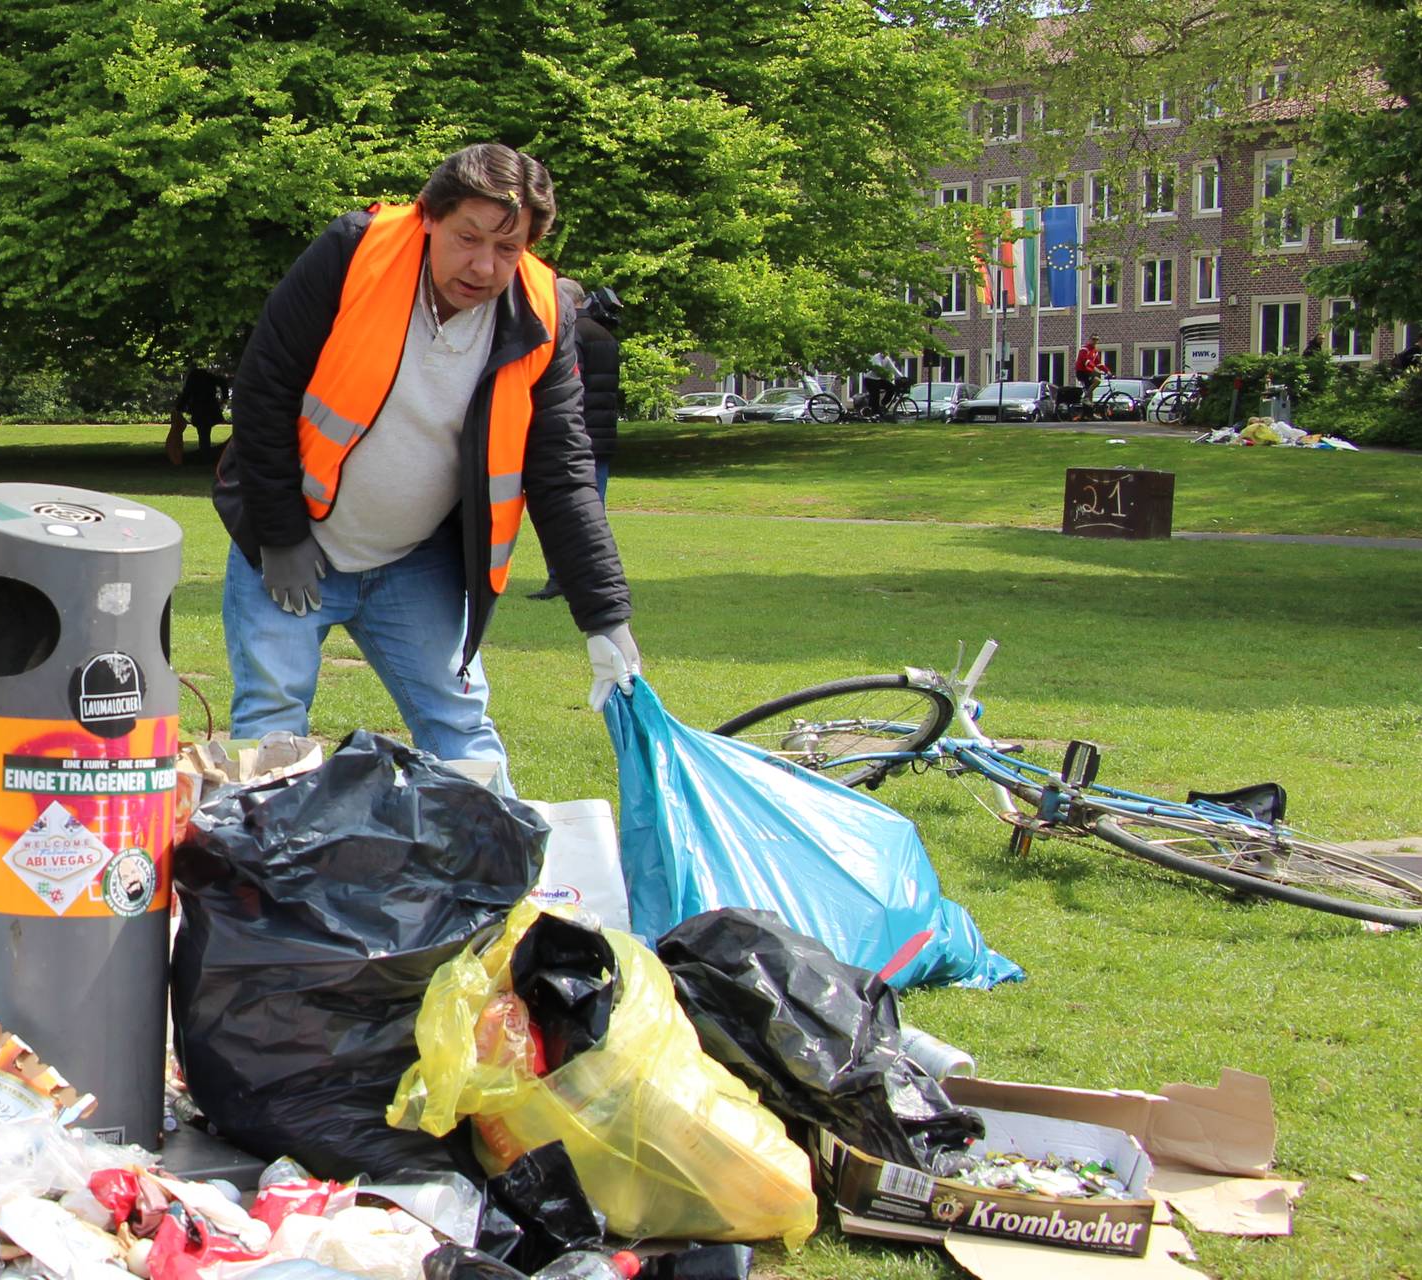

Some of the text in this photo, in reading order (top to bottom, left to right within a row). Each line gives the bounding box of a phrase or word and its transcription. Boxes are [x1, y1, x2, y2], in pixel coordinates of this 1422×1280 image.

[1192, 350, 1210, 358] HWK
[62, 758, 81, 769] EINE
[82, 758, 110, 770] KURVE
[4, 768, 146, 792] EINGETRAGENER
[24, 839, 90, 848] WELCOME
[25, 857, 47, 867] ABI
[51, 853, 94, 866] VEGAS
[967, 1199, 1143, 1246] Krombacher
